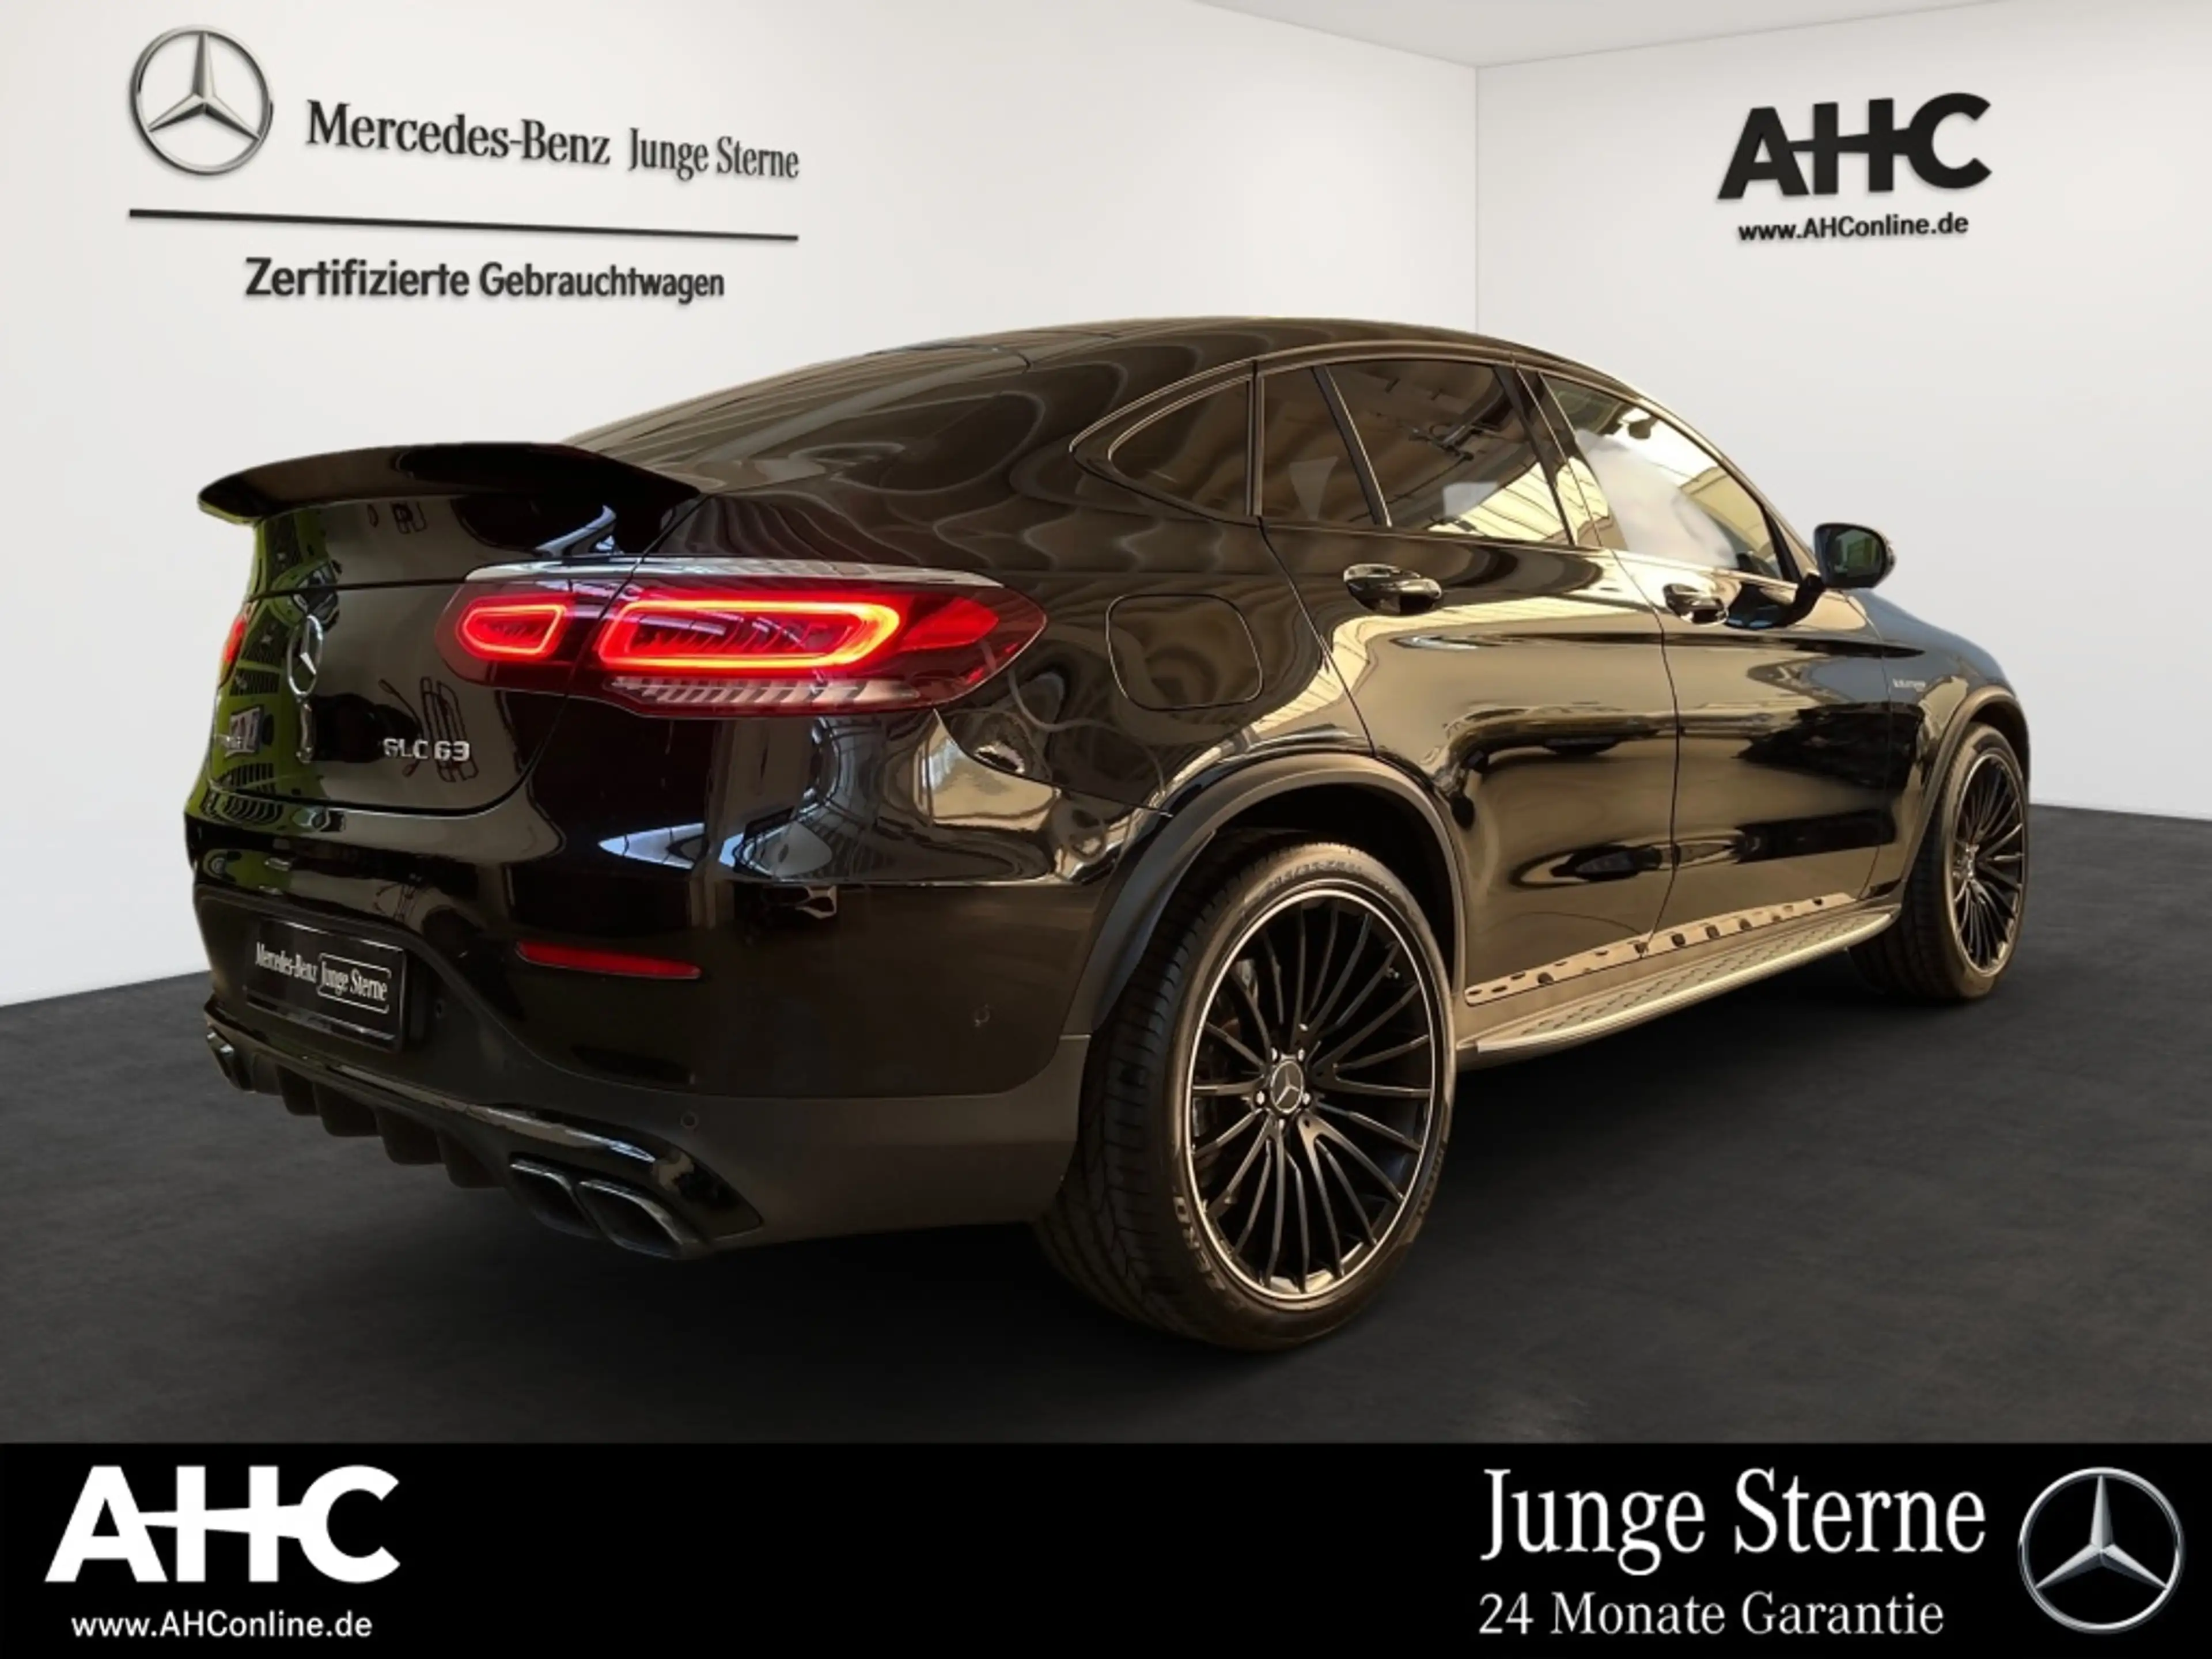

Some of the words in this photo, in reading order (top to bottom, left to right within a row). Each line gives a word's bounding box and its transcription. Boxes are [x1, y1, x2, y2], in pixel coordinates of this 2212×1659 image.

[307, 100, 610, 165] Mercedes-Benz
[630, 127, 709, 180] Junge
[716, 137, 799, 179] Sterne
[1717, 93, 1991, 200] AHC
[1738, 211, 1969, 241] www.AHConline.de
[245, 257, 469, 297] Zertifizierte
[479, 262, 724, 305] Gebrauchtwagen
[383, 737, 429, 759] GLC
[434, 740, 470, 762] 63
[255, 941, 319, 983] Mercedes-Benz
[321, 960, 349, 997] Junge
[350, 968, 388, 1002] Sterne
